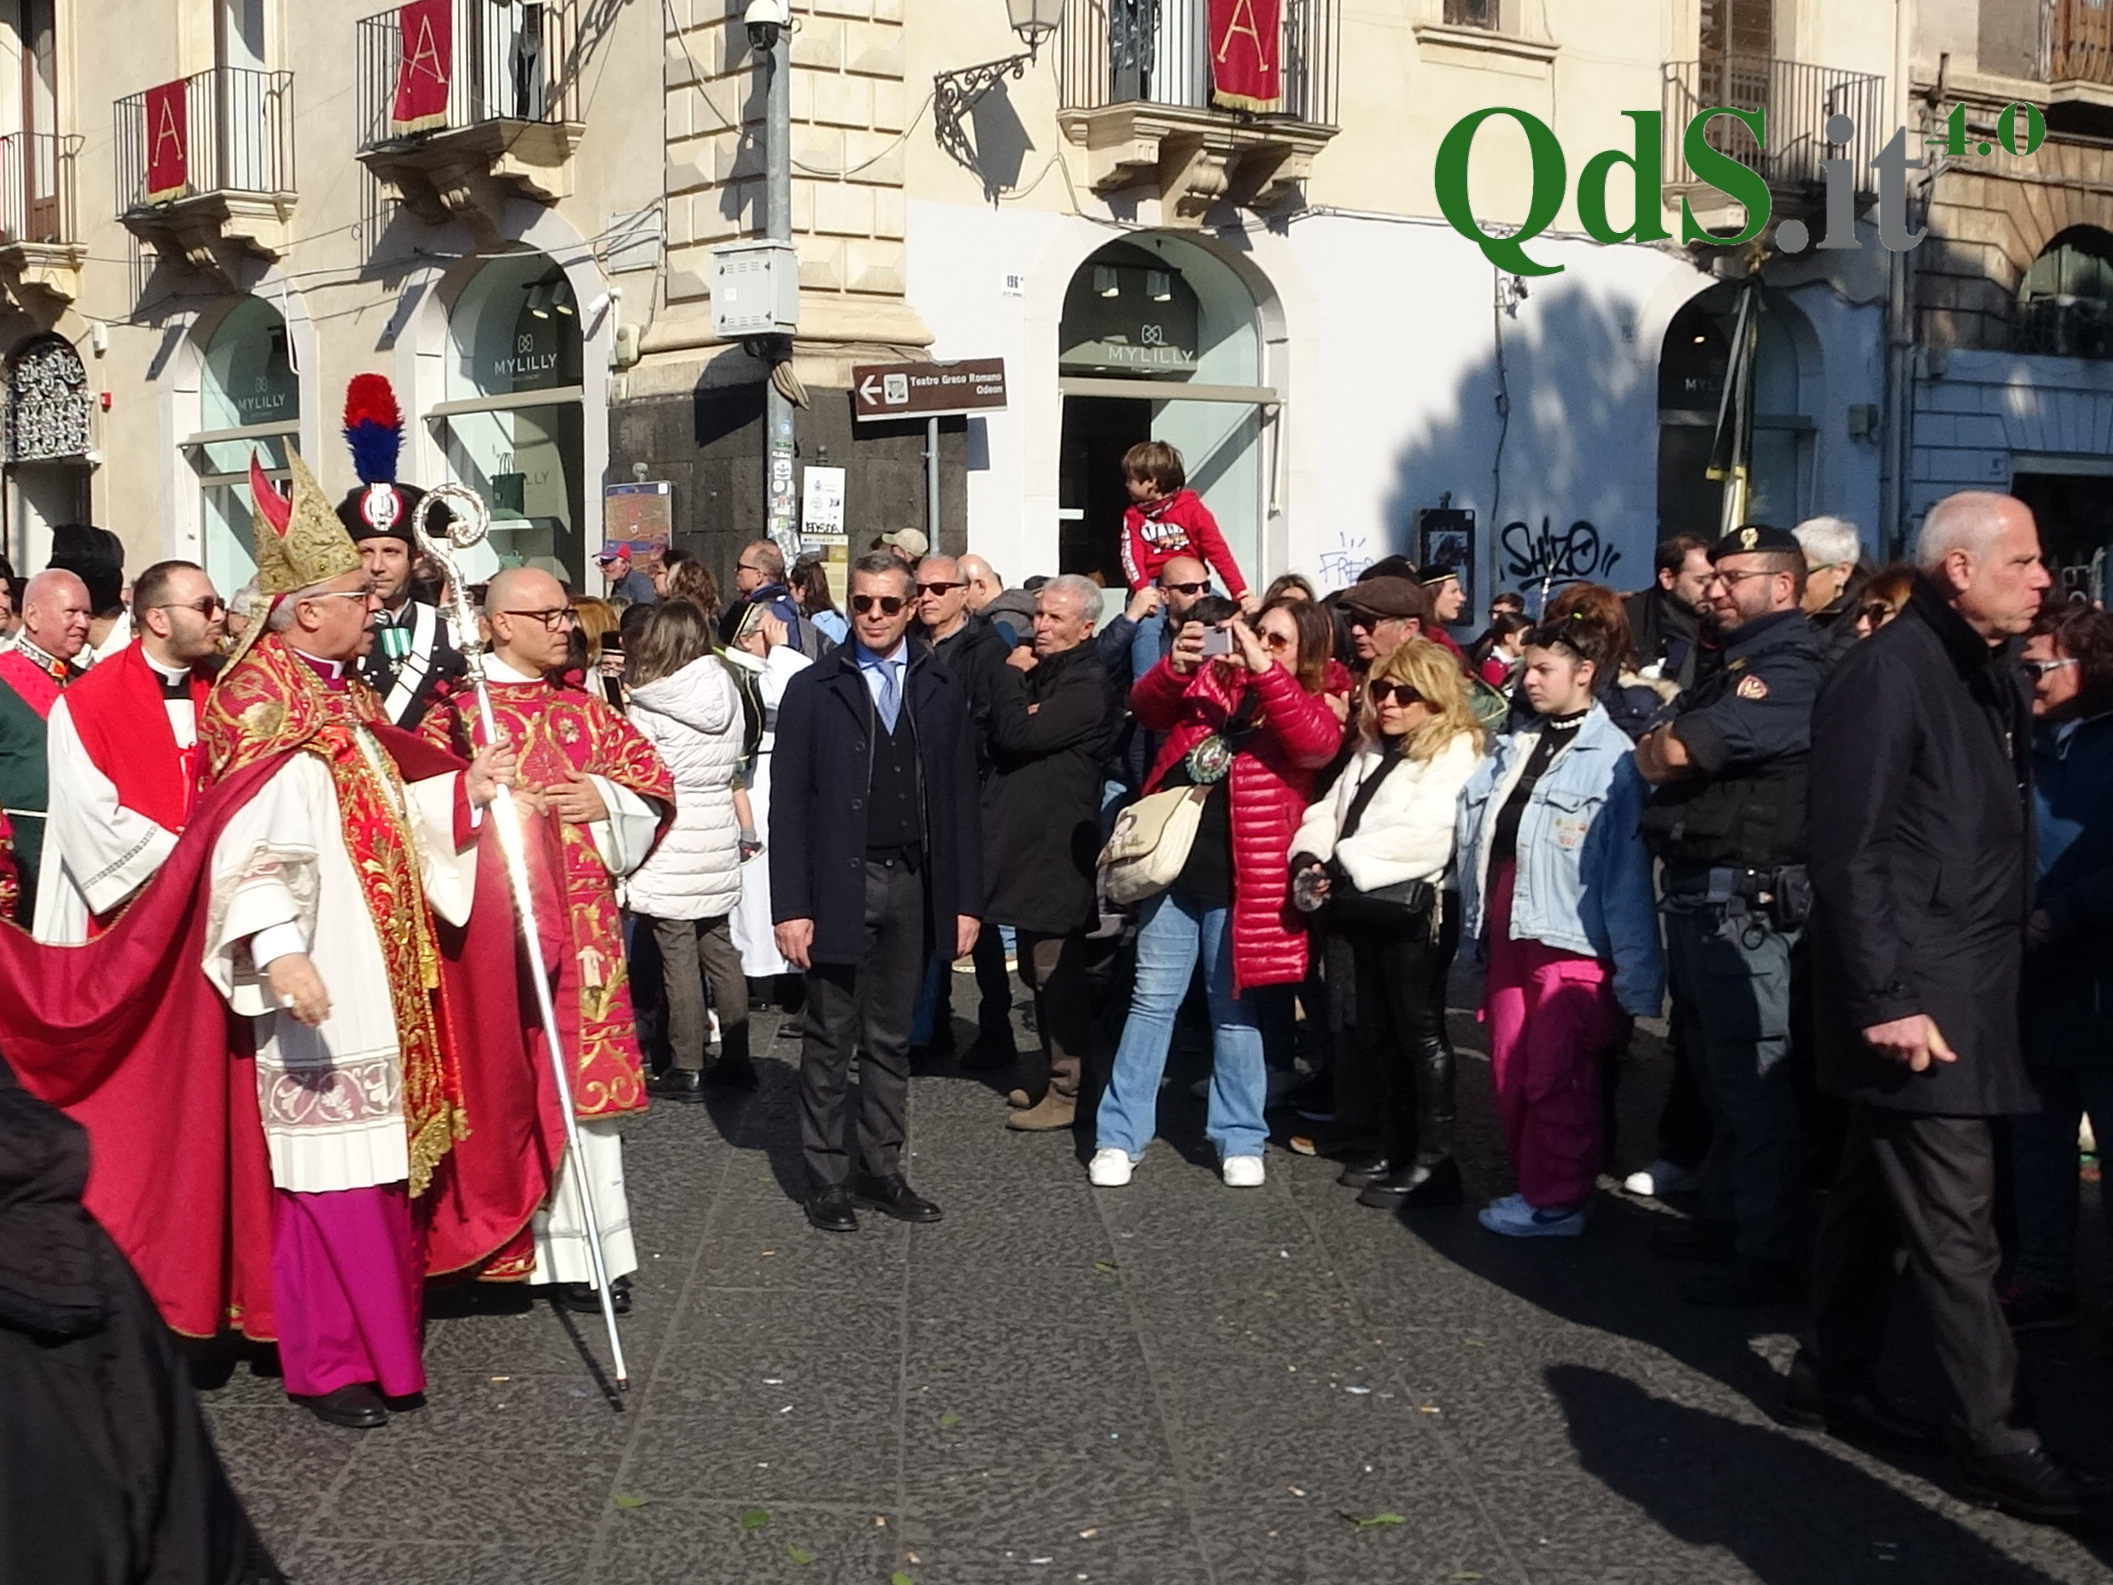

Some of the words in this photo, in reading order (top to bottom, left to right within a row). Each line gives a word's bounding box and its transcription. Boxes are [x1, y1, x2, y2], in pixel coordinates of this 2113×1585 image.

[1216, 0, 1269, 72] A
[407, 14, 447, 93] A
[153, 96, 184, 167] A
[494, 353, 558, 375] MYLILLY
[1108, 346, 1194, 364] MYLILLY
[911, 376, 940, 387] Teatro
[942, 375, 967, 385] Greco
[969, 373, 1002, 383] Romano
[976, 385, 1003, 395] Odeon
[238, 393, 286, 410] MYLILLY
